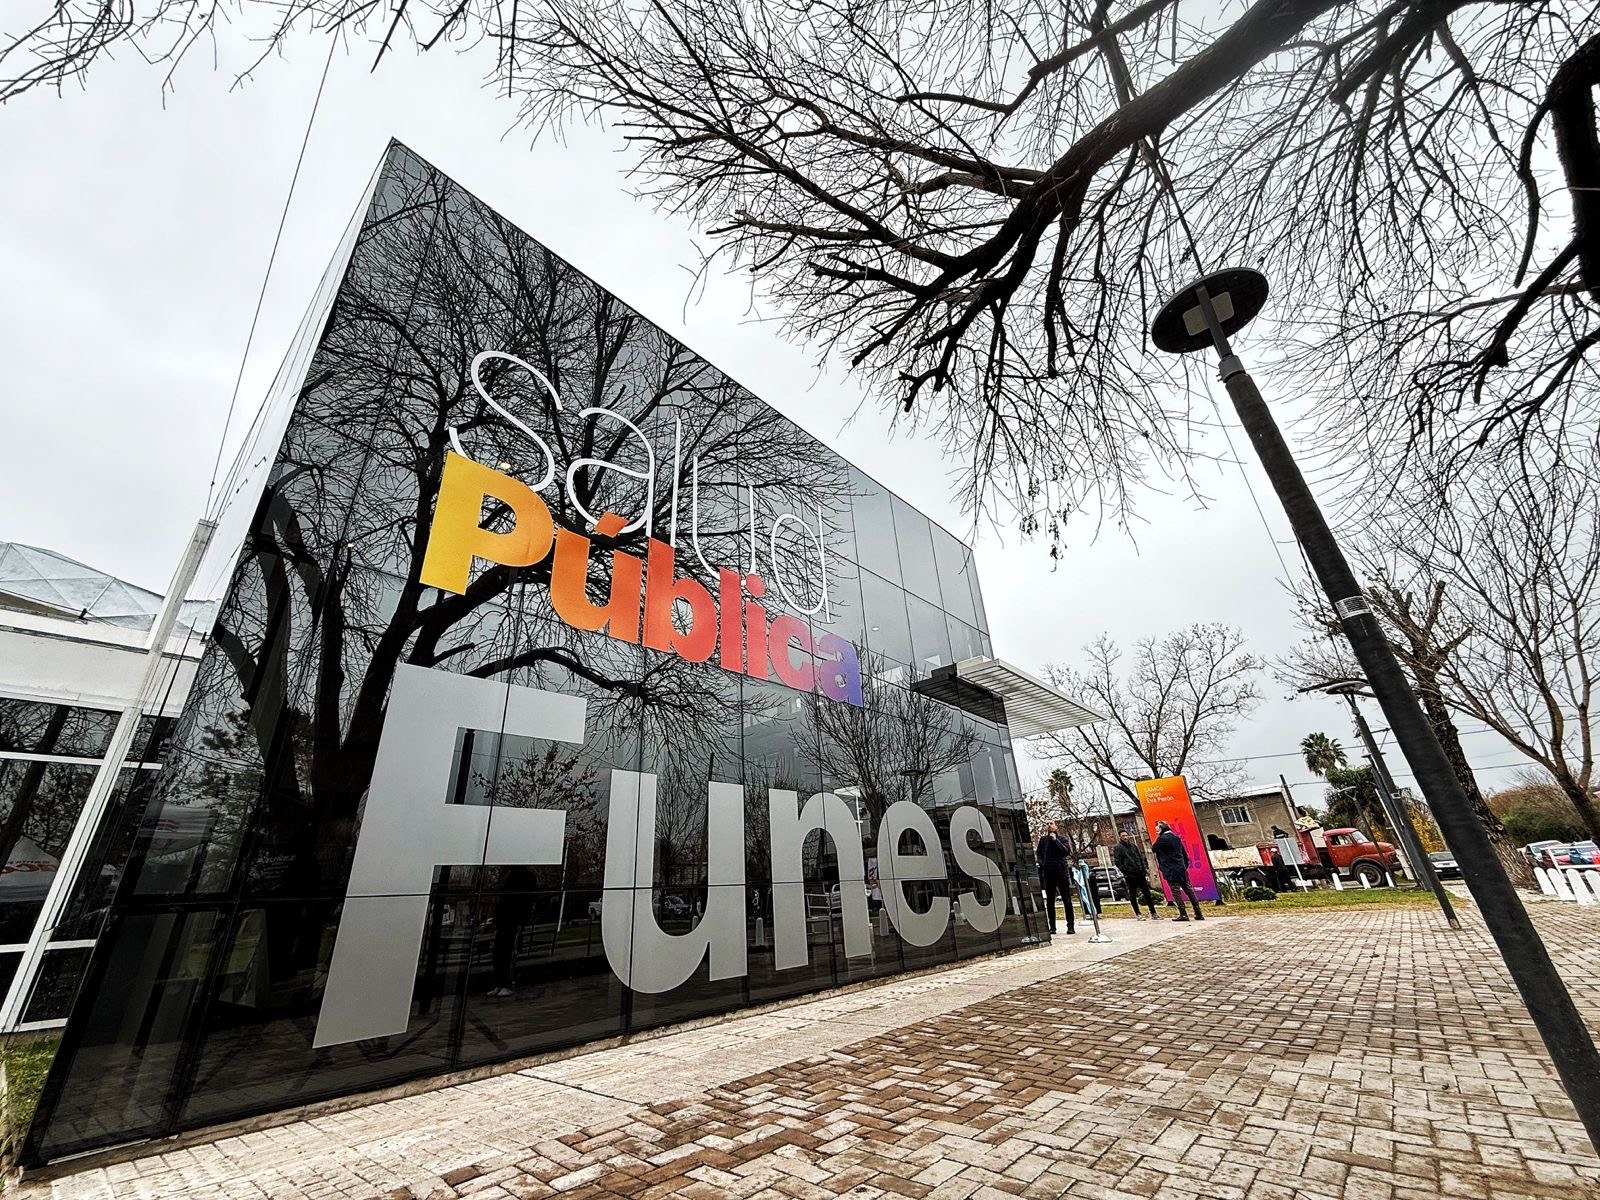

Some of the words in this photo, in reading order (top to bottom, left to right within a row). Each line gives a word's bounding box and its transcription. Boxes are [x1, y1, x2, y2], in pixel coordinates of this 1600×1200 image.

[419, 450, 864, 707] Pública
[449, 350, 831, 624] Salud
[312, 663, 1008, 1049] Funes
[1157, 795, 1175, 803] Perón
